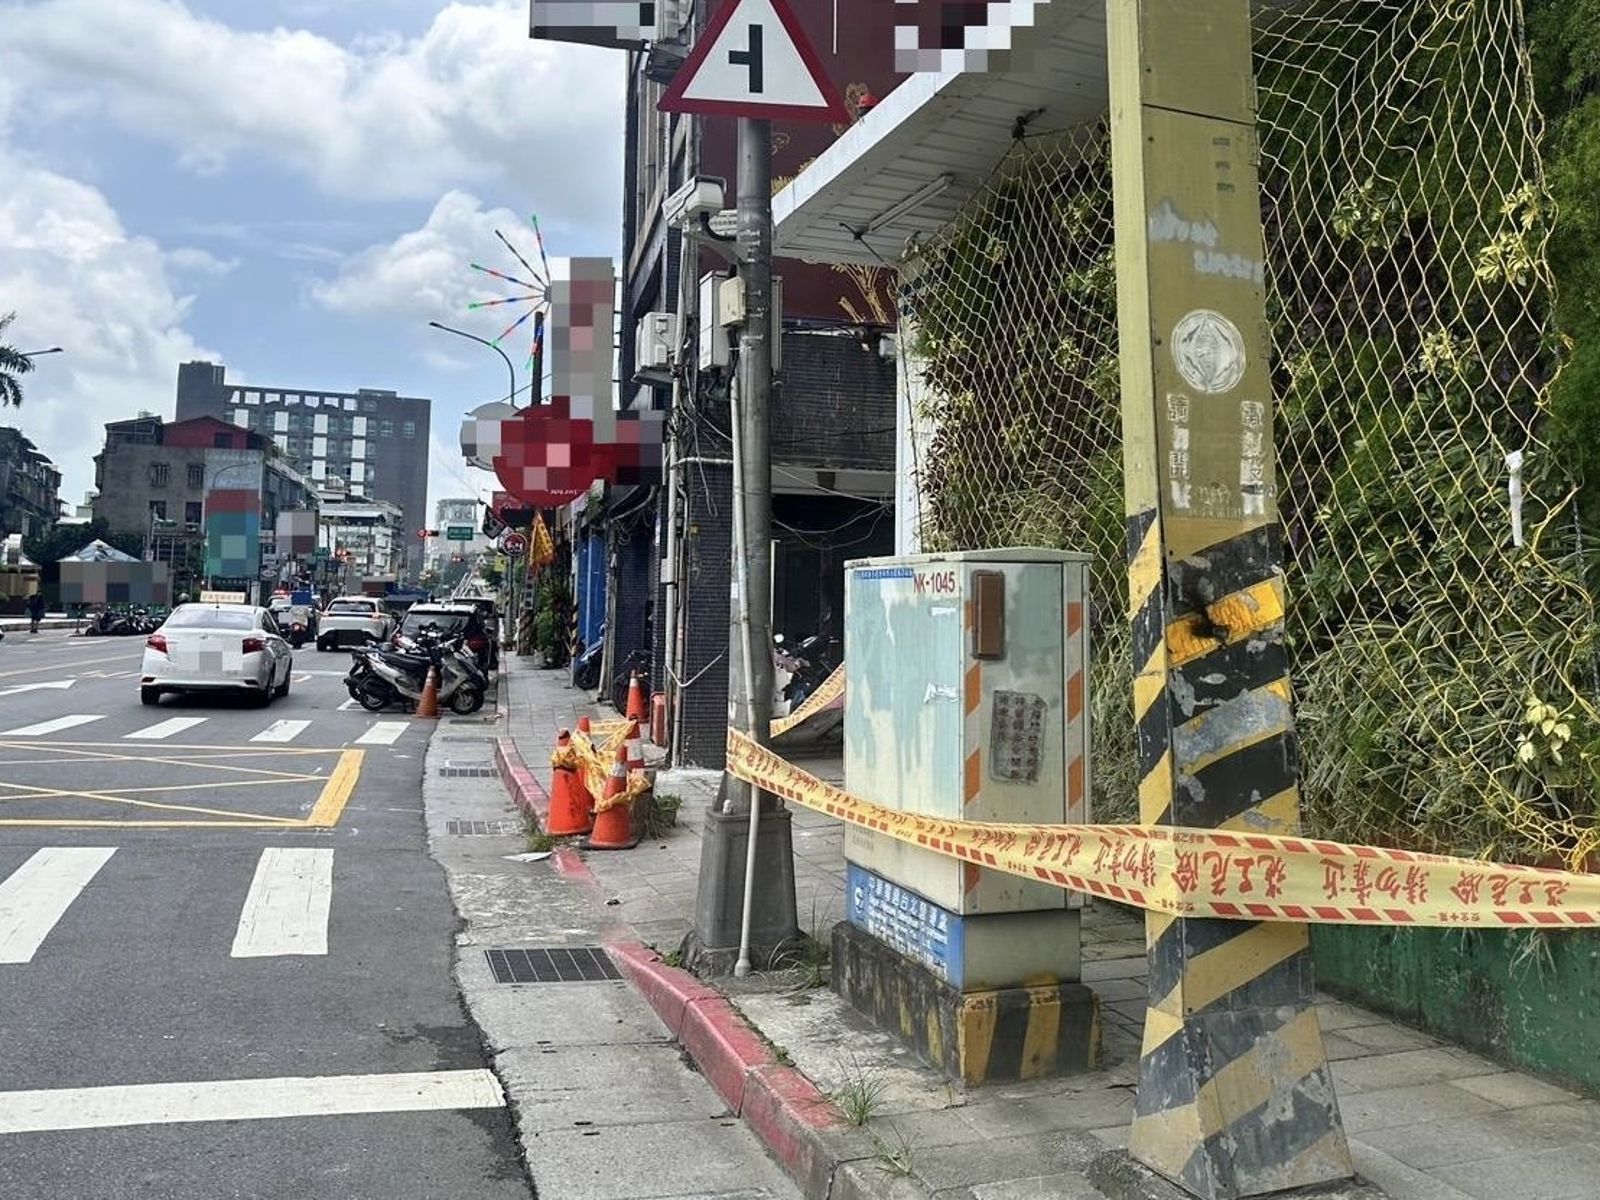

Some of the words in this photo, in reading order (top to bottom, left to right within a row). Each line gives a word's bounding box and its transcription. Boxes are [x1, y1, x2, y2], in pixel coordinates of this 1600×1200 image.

[1171, 848, 1287, 899] 施工危險
[1319, 858, 1430, 906] 請勿靠近
[1449, 869, 1571, 907] 施工危險
